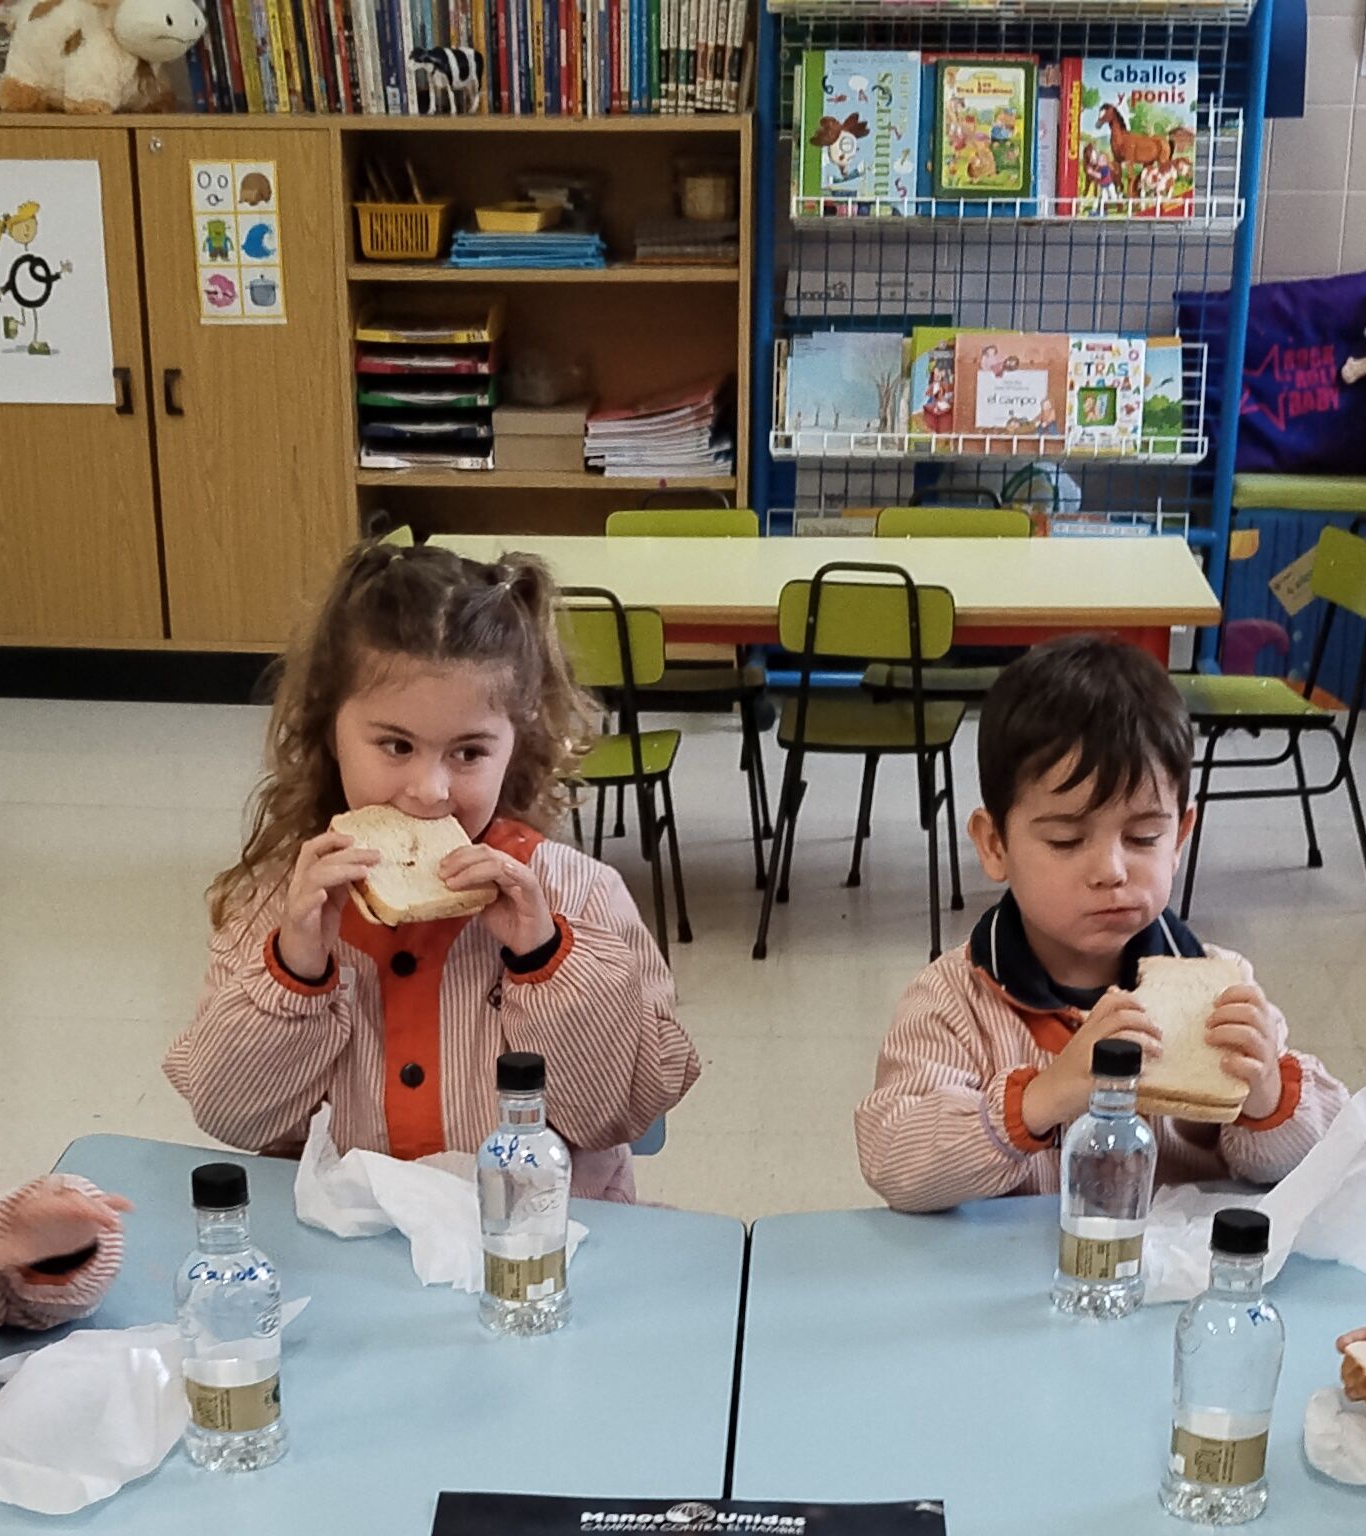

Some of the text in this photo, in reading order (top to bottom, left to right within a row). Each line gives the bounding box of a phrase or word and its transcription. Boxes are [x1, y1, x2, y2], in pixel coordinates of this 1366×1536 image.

[1100, 64, 1186, 85] Caballos
[1117, 86, 1186, 107] y ponis
[580, 1511, 807, 1526] Manos Unidas
